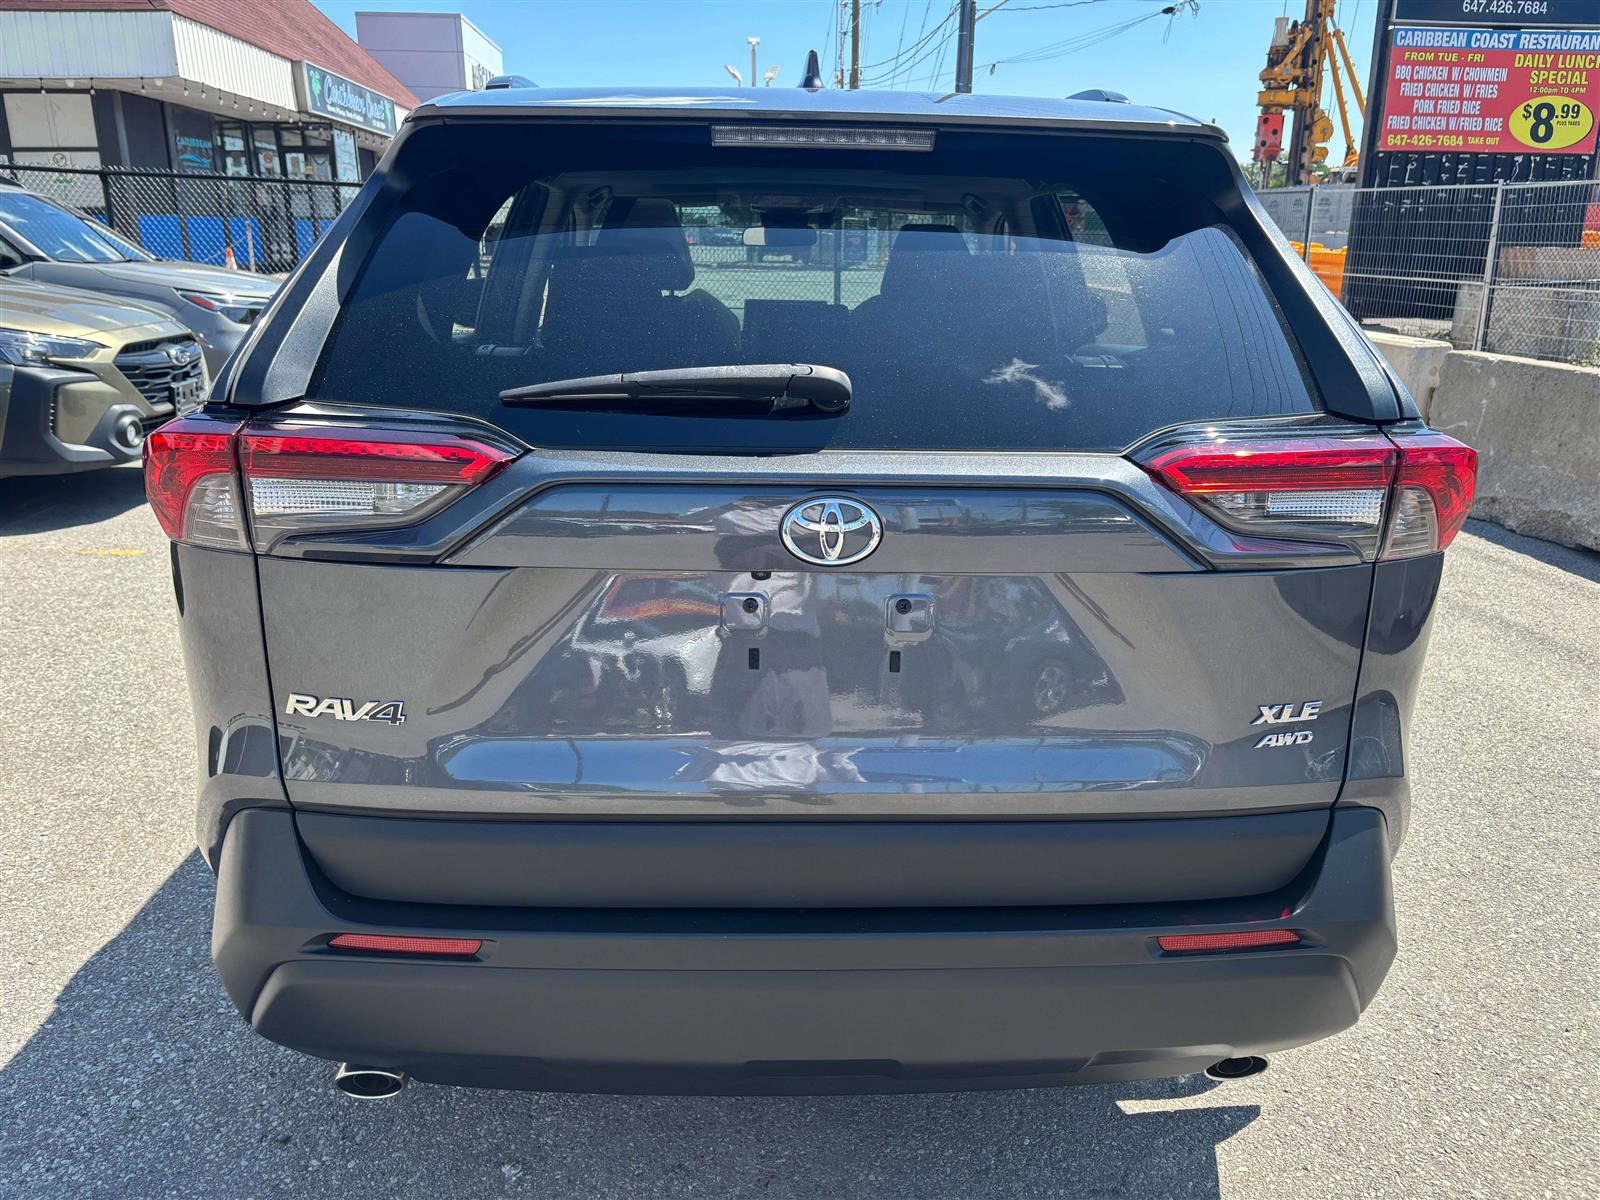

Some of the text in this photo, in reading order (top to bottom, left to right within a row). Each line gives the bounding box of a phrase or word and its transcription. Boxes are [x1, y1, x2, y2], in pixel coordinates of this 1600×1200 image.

[1462, 0, 1548, 14] 647.426.7684
[1396, 30, 1468, 47] CARIBBEAN
[1471, 32, 1517, 48] COAST
[1404, 52, 1435, 61] FROM
[1437, 52, 1459, 62] TUE
[1467, 53, 1485, 62] FRI
[1514, 53, 1555, 68] DAILY
[1395, 65, 1412, 80] BBQ
[1413, 65, 1449, 81] CHICKEN
[1529, 70, 1589, 84] SPECIAL
[1400, 82, 1423, 97] FRIED
[1425, 83, 1460, 97] CHICKEN
[1413, 99, 1481, 115] PORK FRIED RICE
[1387, 115, 1410, 130] FRIED
[1412, 115, 1446, 130] CHICKEN
[1484, 117, 1504, 132] RICE
[1387, 134, 1500, 146] 647-426-7684 TAKE OUT
[285, 692, 406, 726] RAV4
[1249, 700, 1323, 726] XLE
[1253, 730, 1314, 749] AWD
